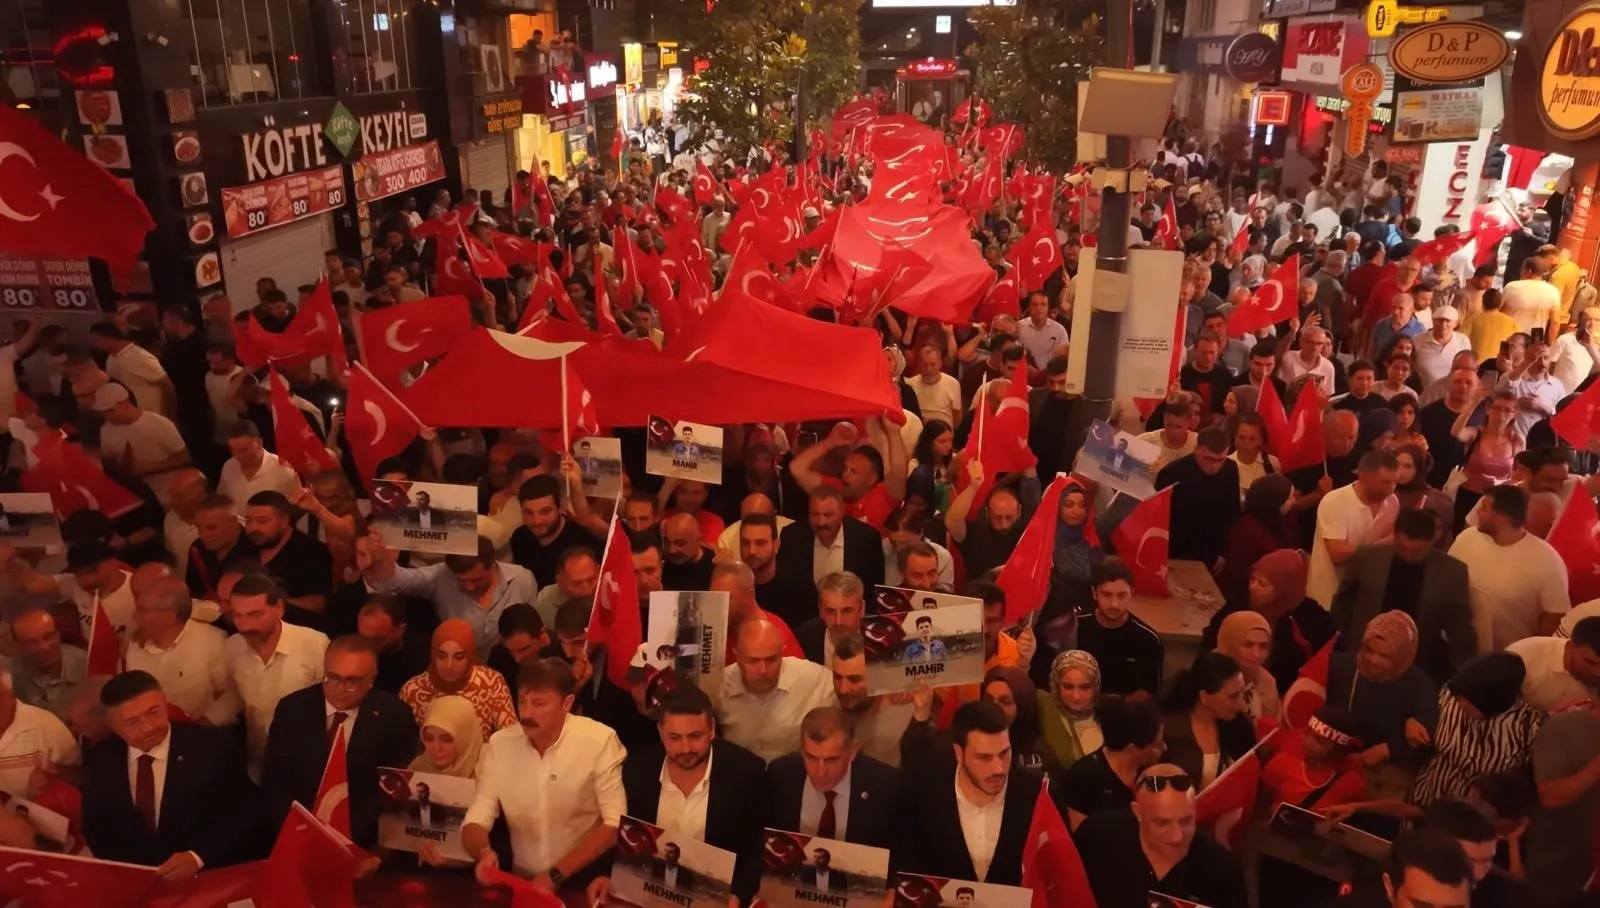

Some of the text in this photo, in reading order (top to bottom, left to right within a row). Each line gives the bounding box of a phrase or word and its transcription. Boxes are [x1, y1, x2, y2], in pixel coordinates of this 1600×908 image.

[1553, 27, 1600, 77] D&
[1413, 53, 1489, 70] perfumum
[359, 101, 410, 154] KEYFİ
[241, 115, 326, 182] KÖFTE
[385, 167, 428, 192] 300 400
[1441, 144, 1471, 223] ECZ
[329, 190, 341, 205] 80
[293, 200, 307, 215] 80
[248, 211, 266, 228] 80
[3, 288, 35, 306] 80
[54, 289, 87, 307] 80
[403, 529, 448, 541] MEHMET
[701, 624, 712, 674] MEHMET
[405, 826, 447, 842] MEHMET
[643, 881, 693, 907] MEHMET
[794, 889, 847, 907] MEHMET
